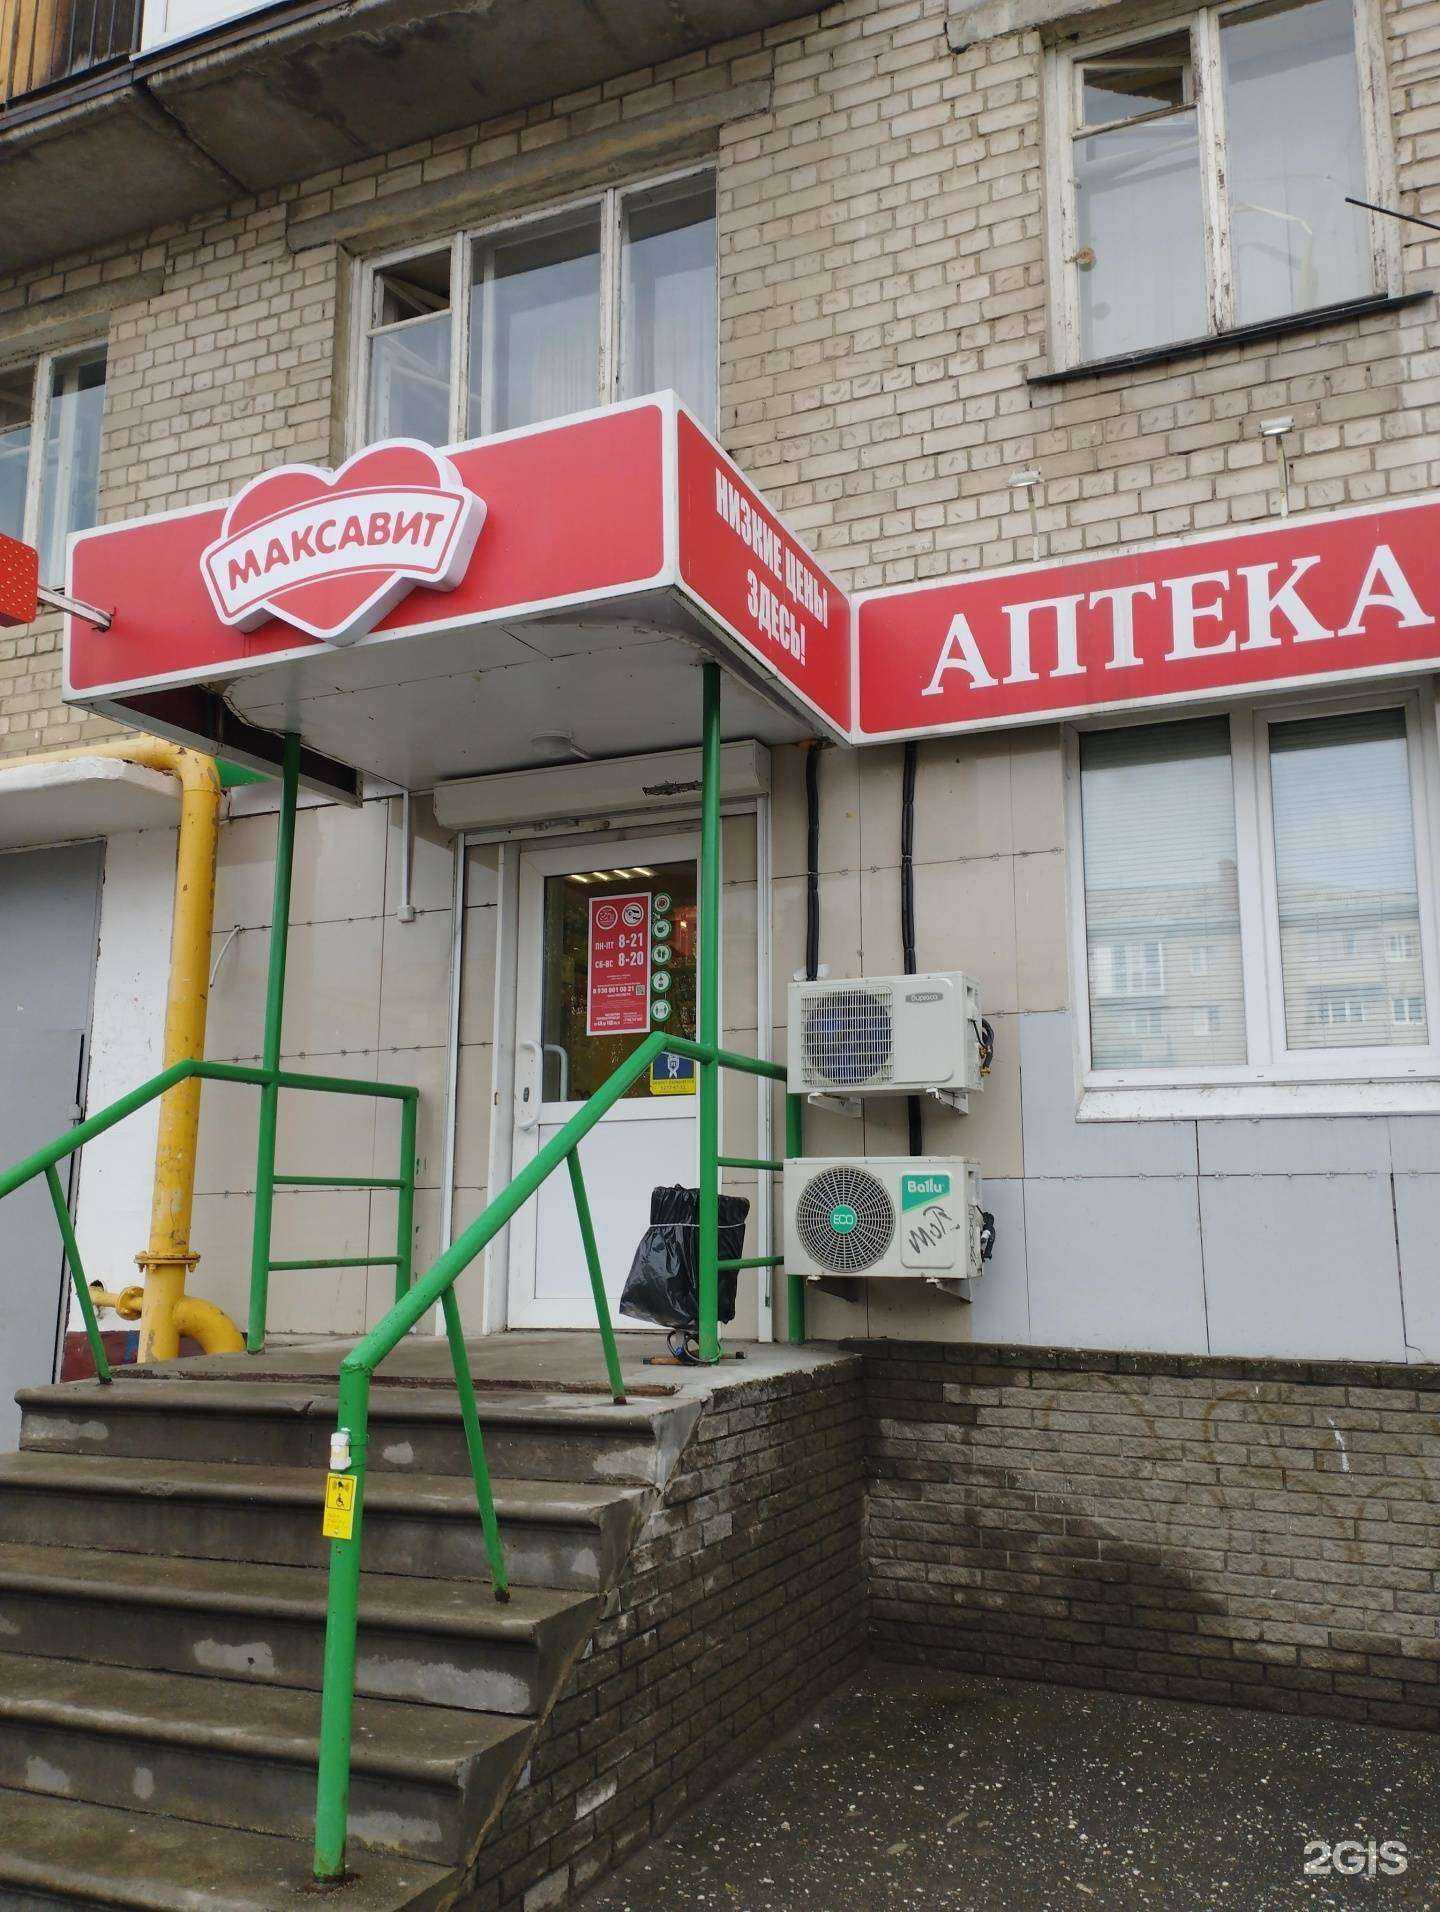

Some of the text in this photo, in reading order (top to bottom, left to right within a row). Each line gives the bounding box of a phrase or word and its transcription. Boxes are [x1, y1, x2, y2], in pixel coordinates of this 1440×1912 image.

[227, 510, 445, 591] МАКСАВИТ
[715, 467, 828, 629] НИЗКИЕ ЦЕНЫ
[747, 568, 806, 667] ЗДЕСЬ!
[921, 543, 1435, 696] АПТЕКА
[618, 933, 643, 948] 8-21
[618, 951, 644, 967] 8-20
[907, 1179, 943, 1193] Ballu
[833, 1214, 854, 1225] ECO
